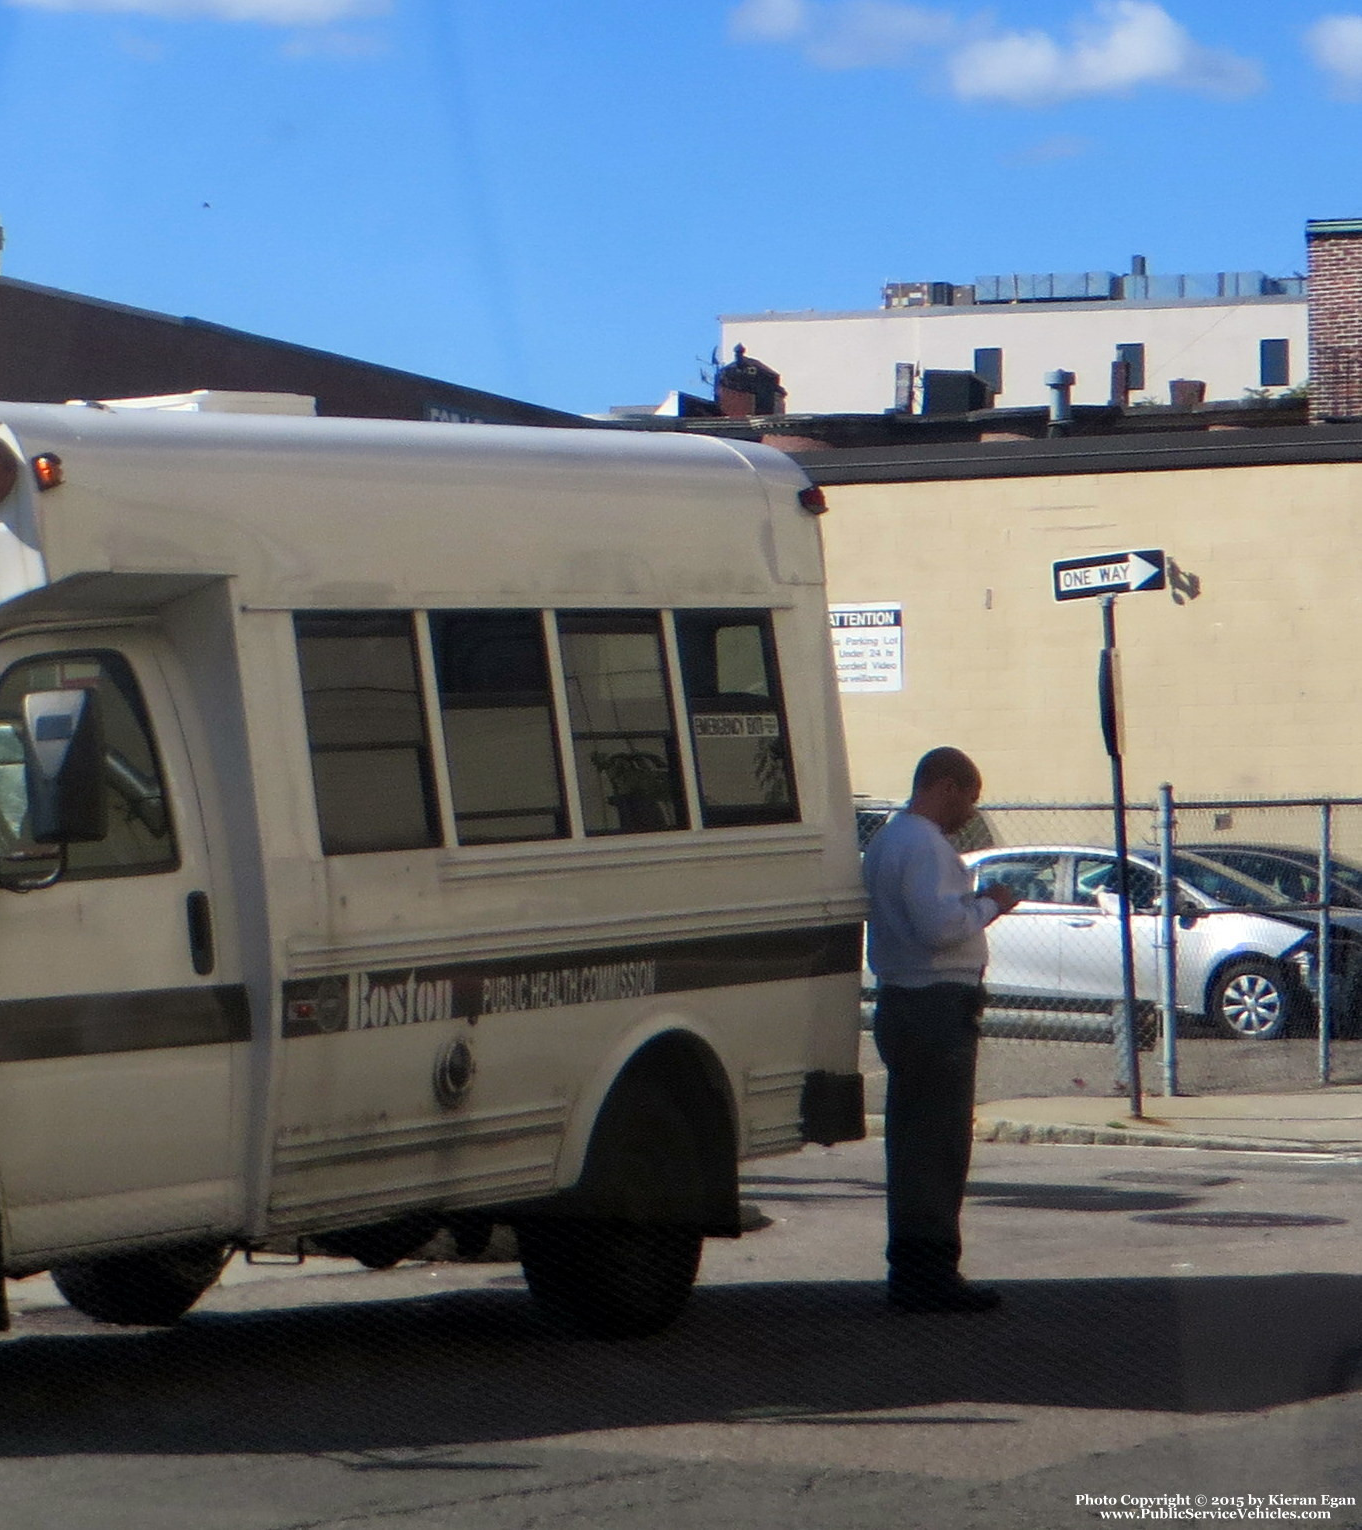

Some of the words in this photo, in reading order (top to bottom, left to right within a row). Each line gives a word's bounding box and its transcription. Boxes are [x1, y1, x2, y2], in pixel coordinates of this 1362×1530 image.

[1063, 570, 1092, 588] ONE
[1099, 564, 1131, 582] WAY
[828, 611, 895, 626] ATTENTION
[846, 636, 880, 646] Parking
[884, 636, 898, 645] Lot
[839, 649, 864, 658] Under
[870, 648, 881, 658] 24
[872, 661, 897, 670] Video
[348, 967, 453, 1031] Boston
[482, 974, 528, 1014] PUBLIC
[530, 967, 578, 1009] HEALTH
[581, 958, 656, 1002] COMMISSION
